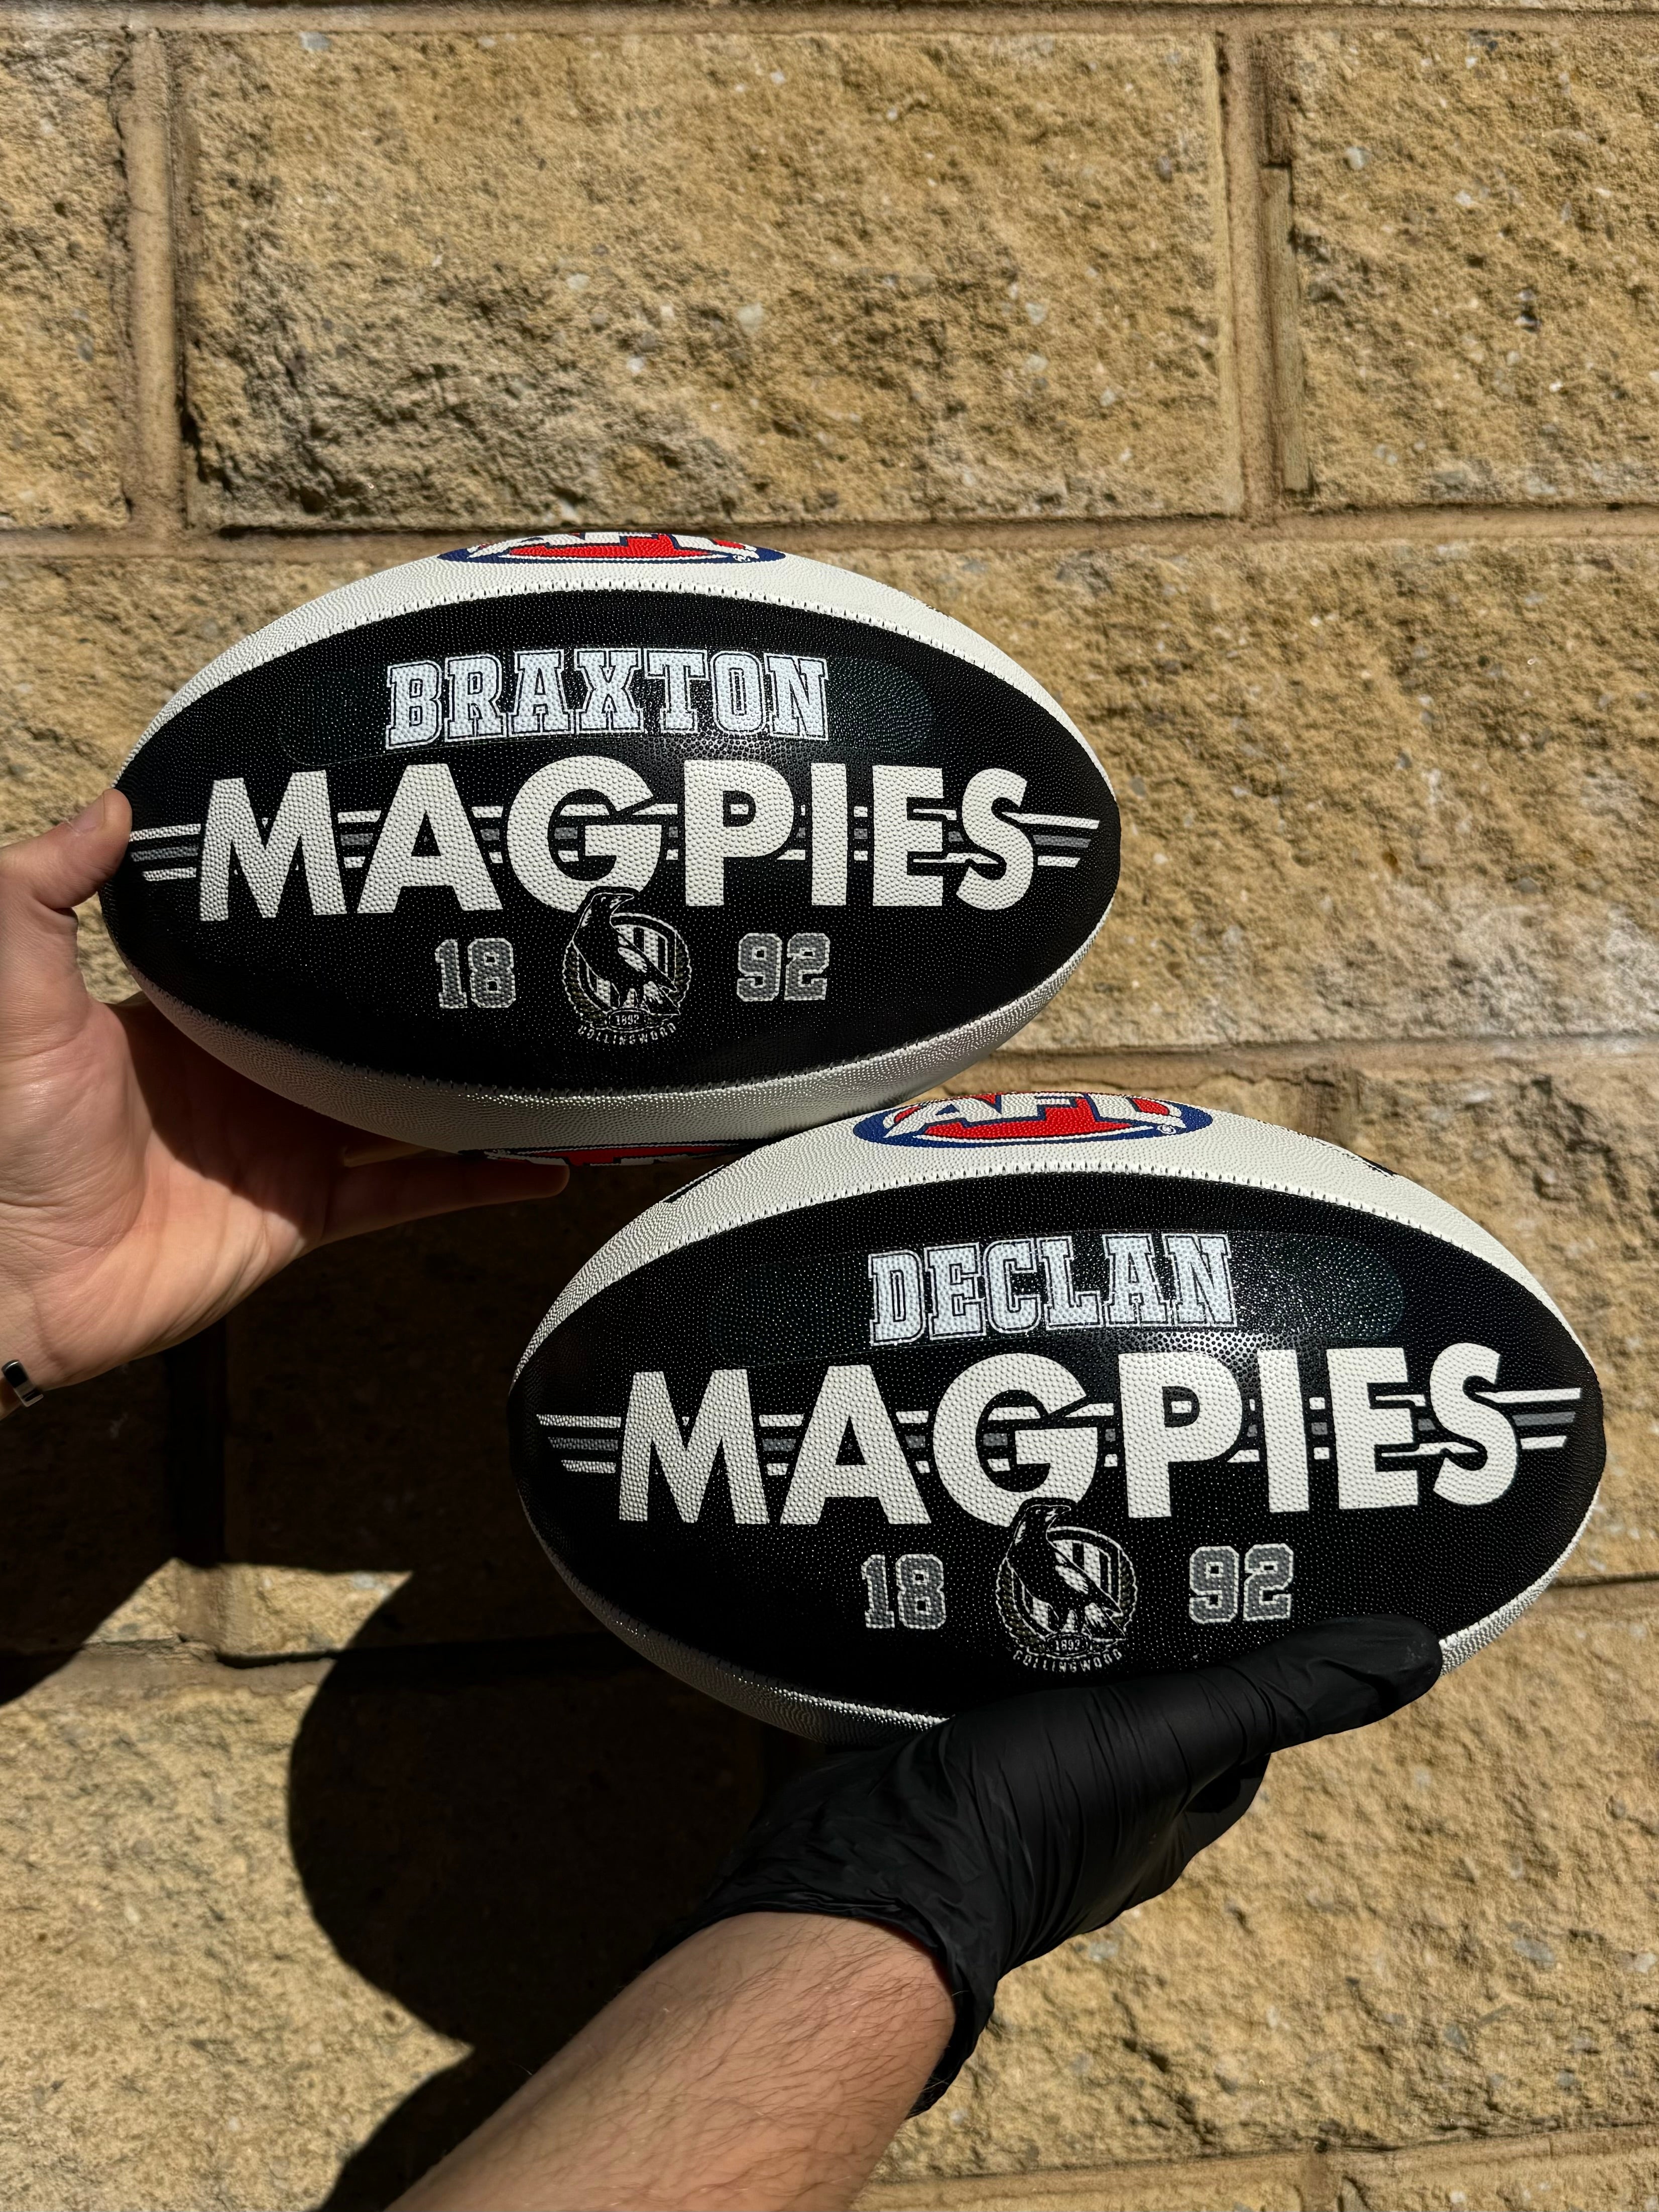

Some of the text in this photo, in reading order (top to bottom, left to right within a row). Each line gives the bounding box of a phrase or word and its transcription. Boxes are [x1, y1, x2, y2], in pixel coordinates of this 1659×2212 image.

[385, 646, 830, 750] BRAXTON
[199, 755, 1034, 921] MAGPIES
[434, 938, 517, 1009] 18
[736, 932, 831, 1002] 92
[868, 1232, 1238, 1347] DECLAN
[618, 1342, 1519, 1528] MAGPIES
[861, 1553, 947, 1630] 18
[1188, 1542, 1294, 1624] 92
